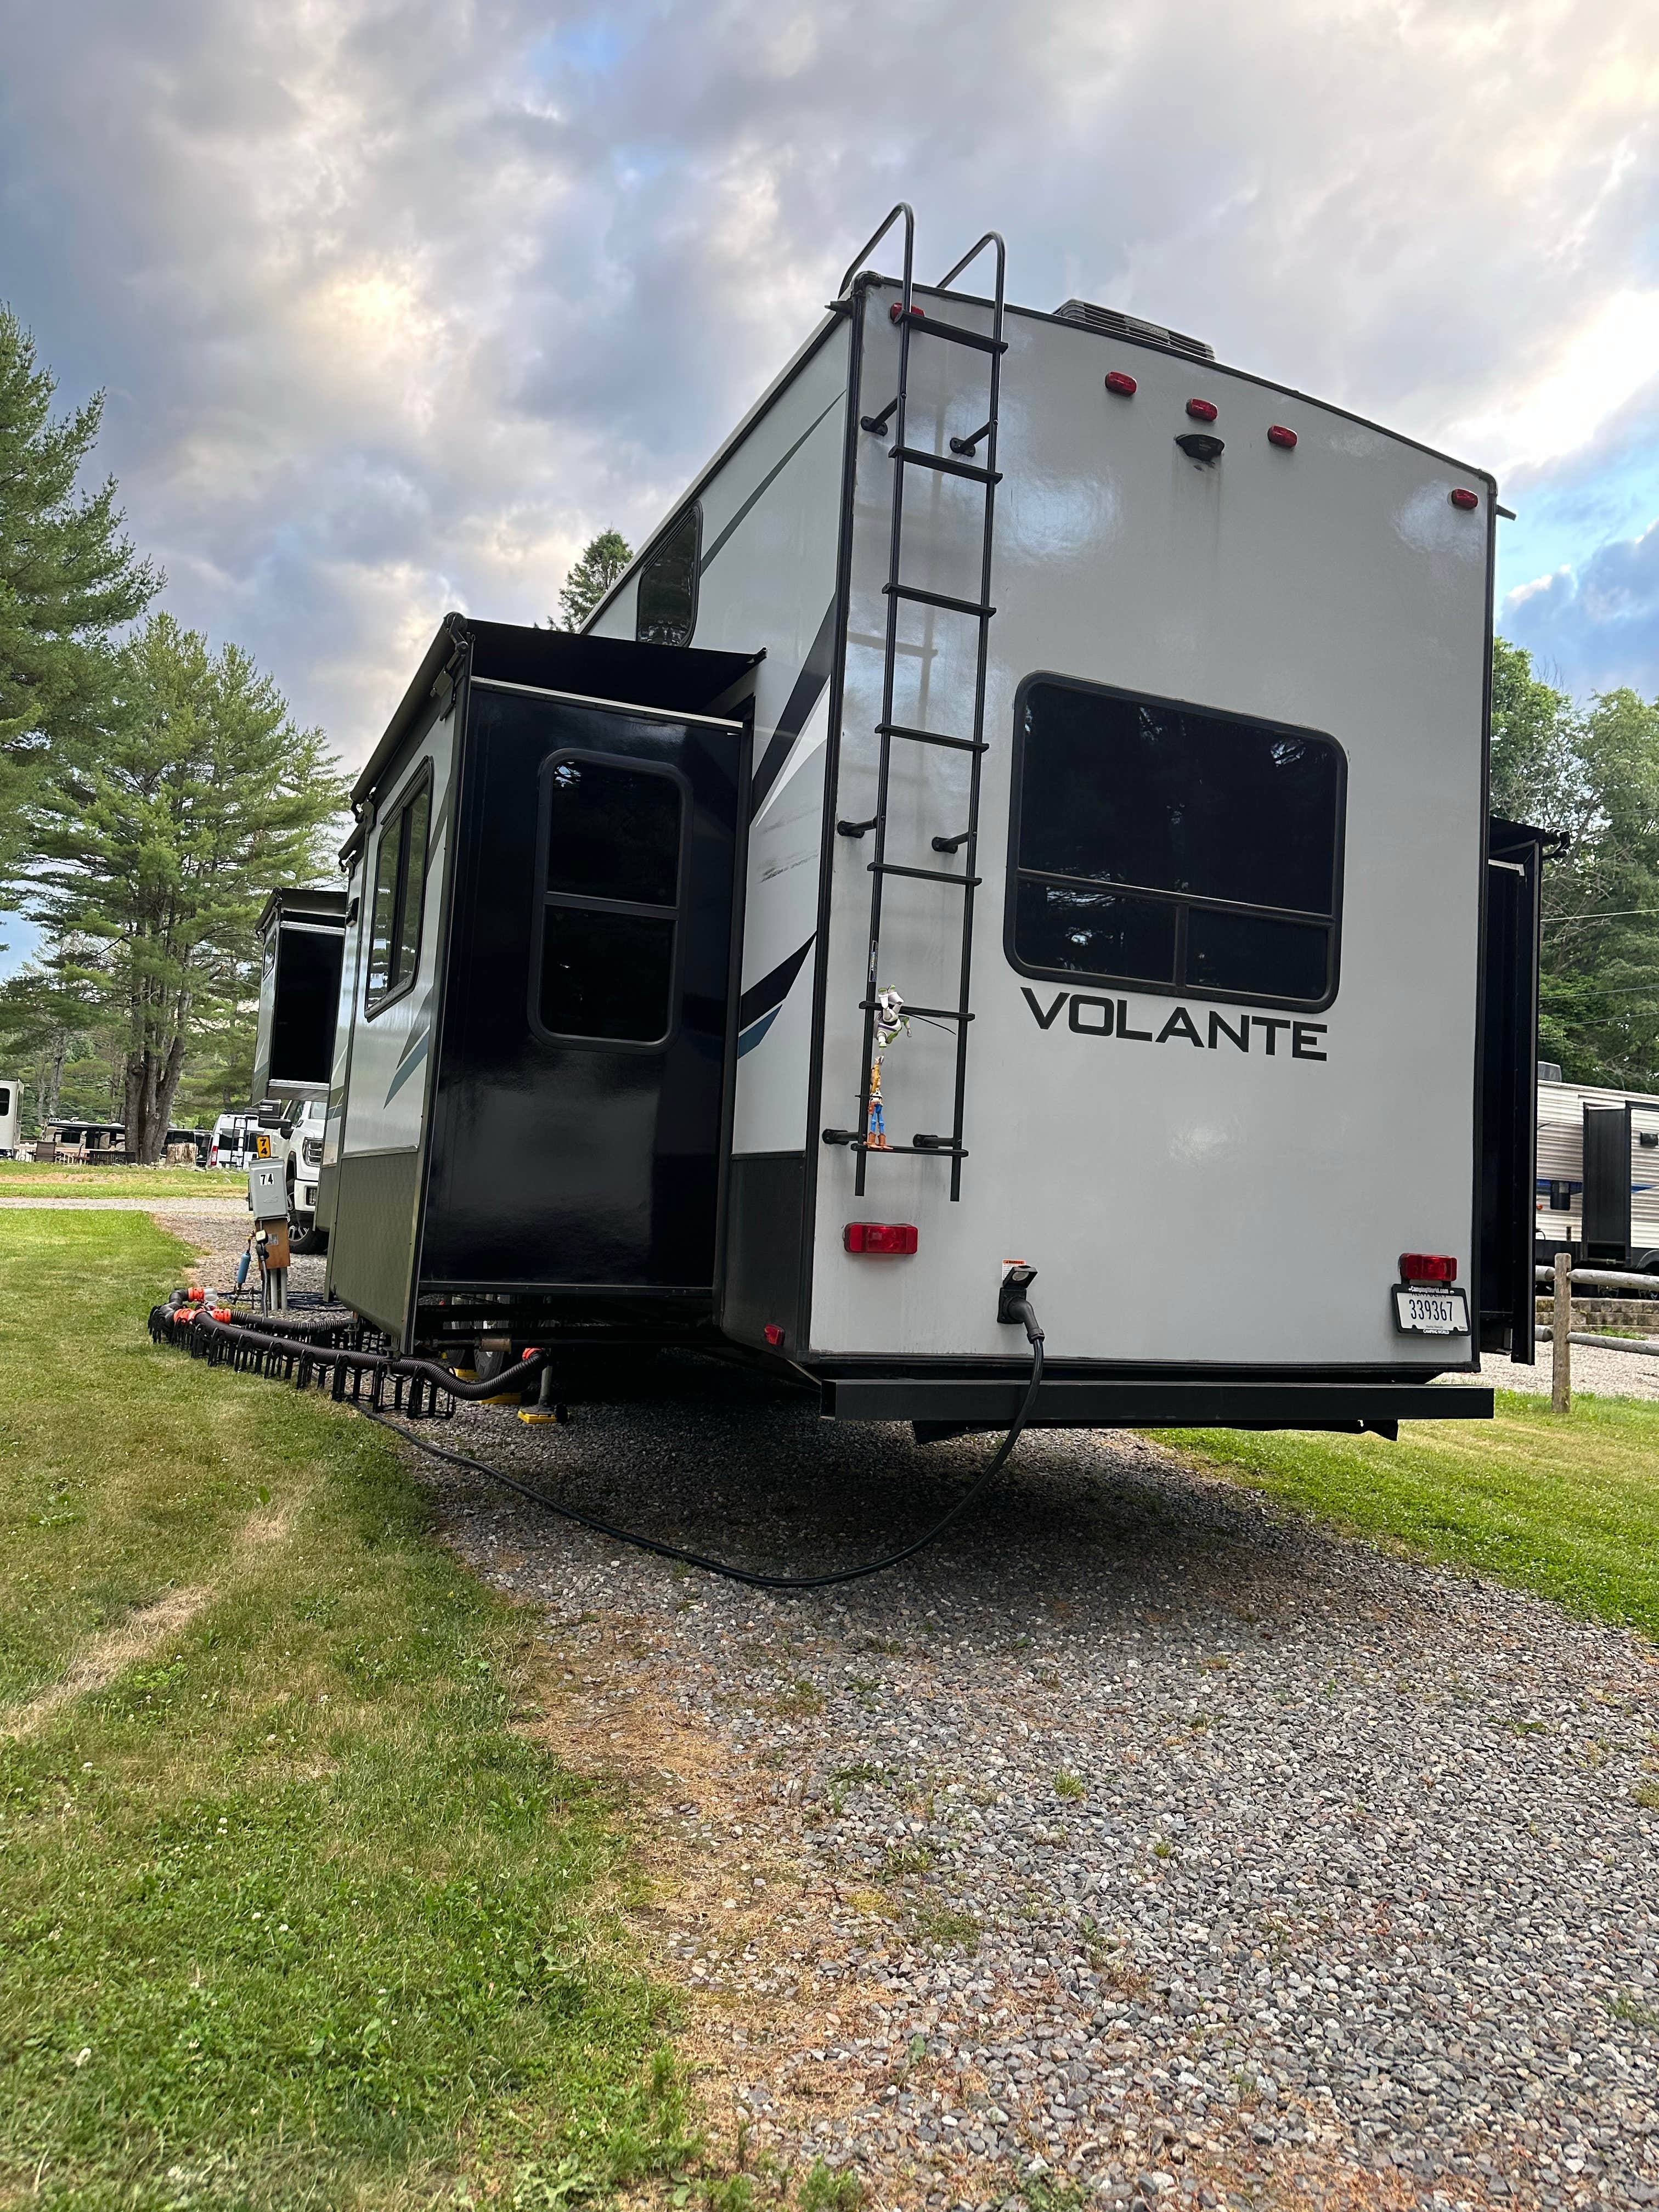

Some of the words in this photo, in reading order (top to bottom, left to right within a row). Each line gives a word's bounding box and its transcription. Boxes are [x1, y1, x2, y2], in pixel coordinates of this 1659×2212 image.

[1020, 987, 1327, 1062] VOLANTE
[261, 1174, 273, 1185] 74
[1409, 1299, 1453, 1322] 339367
